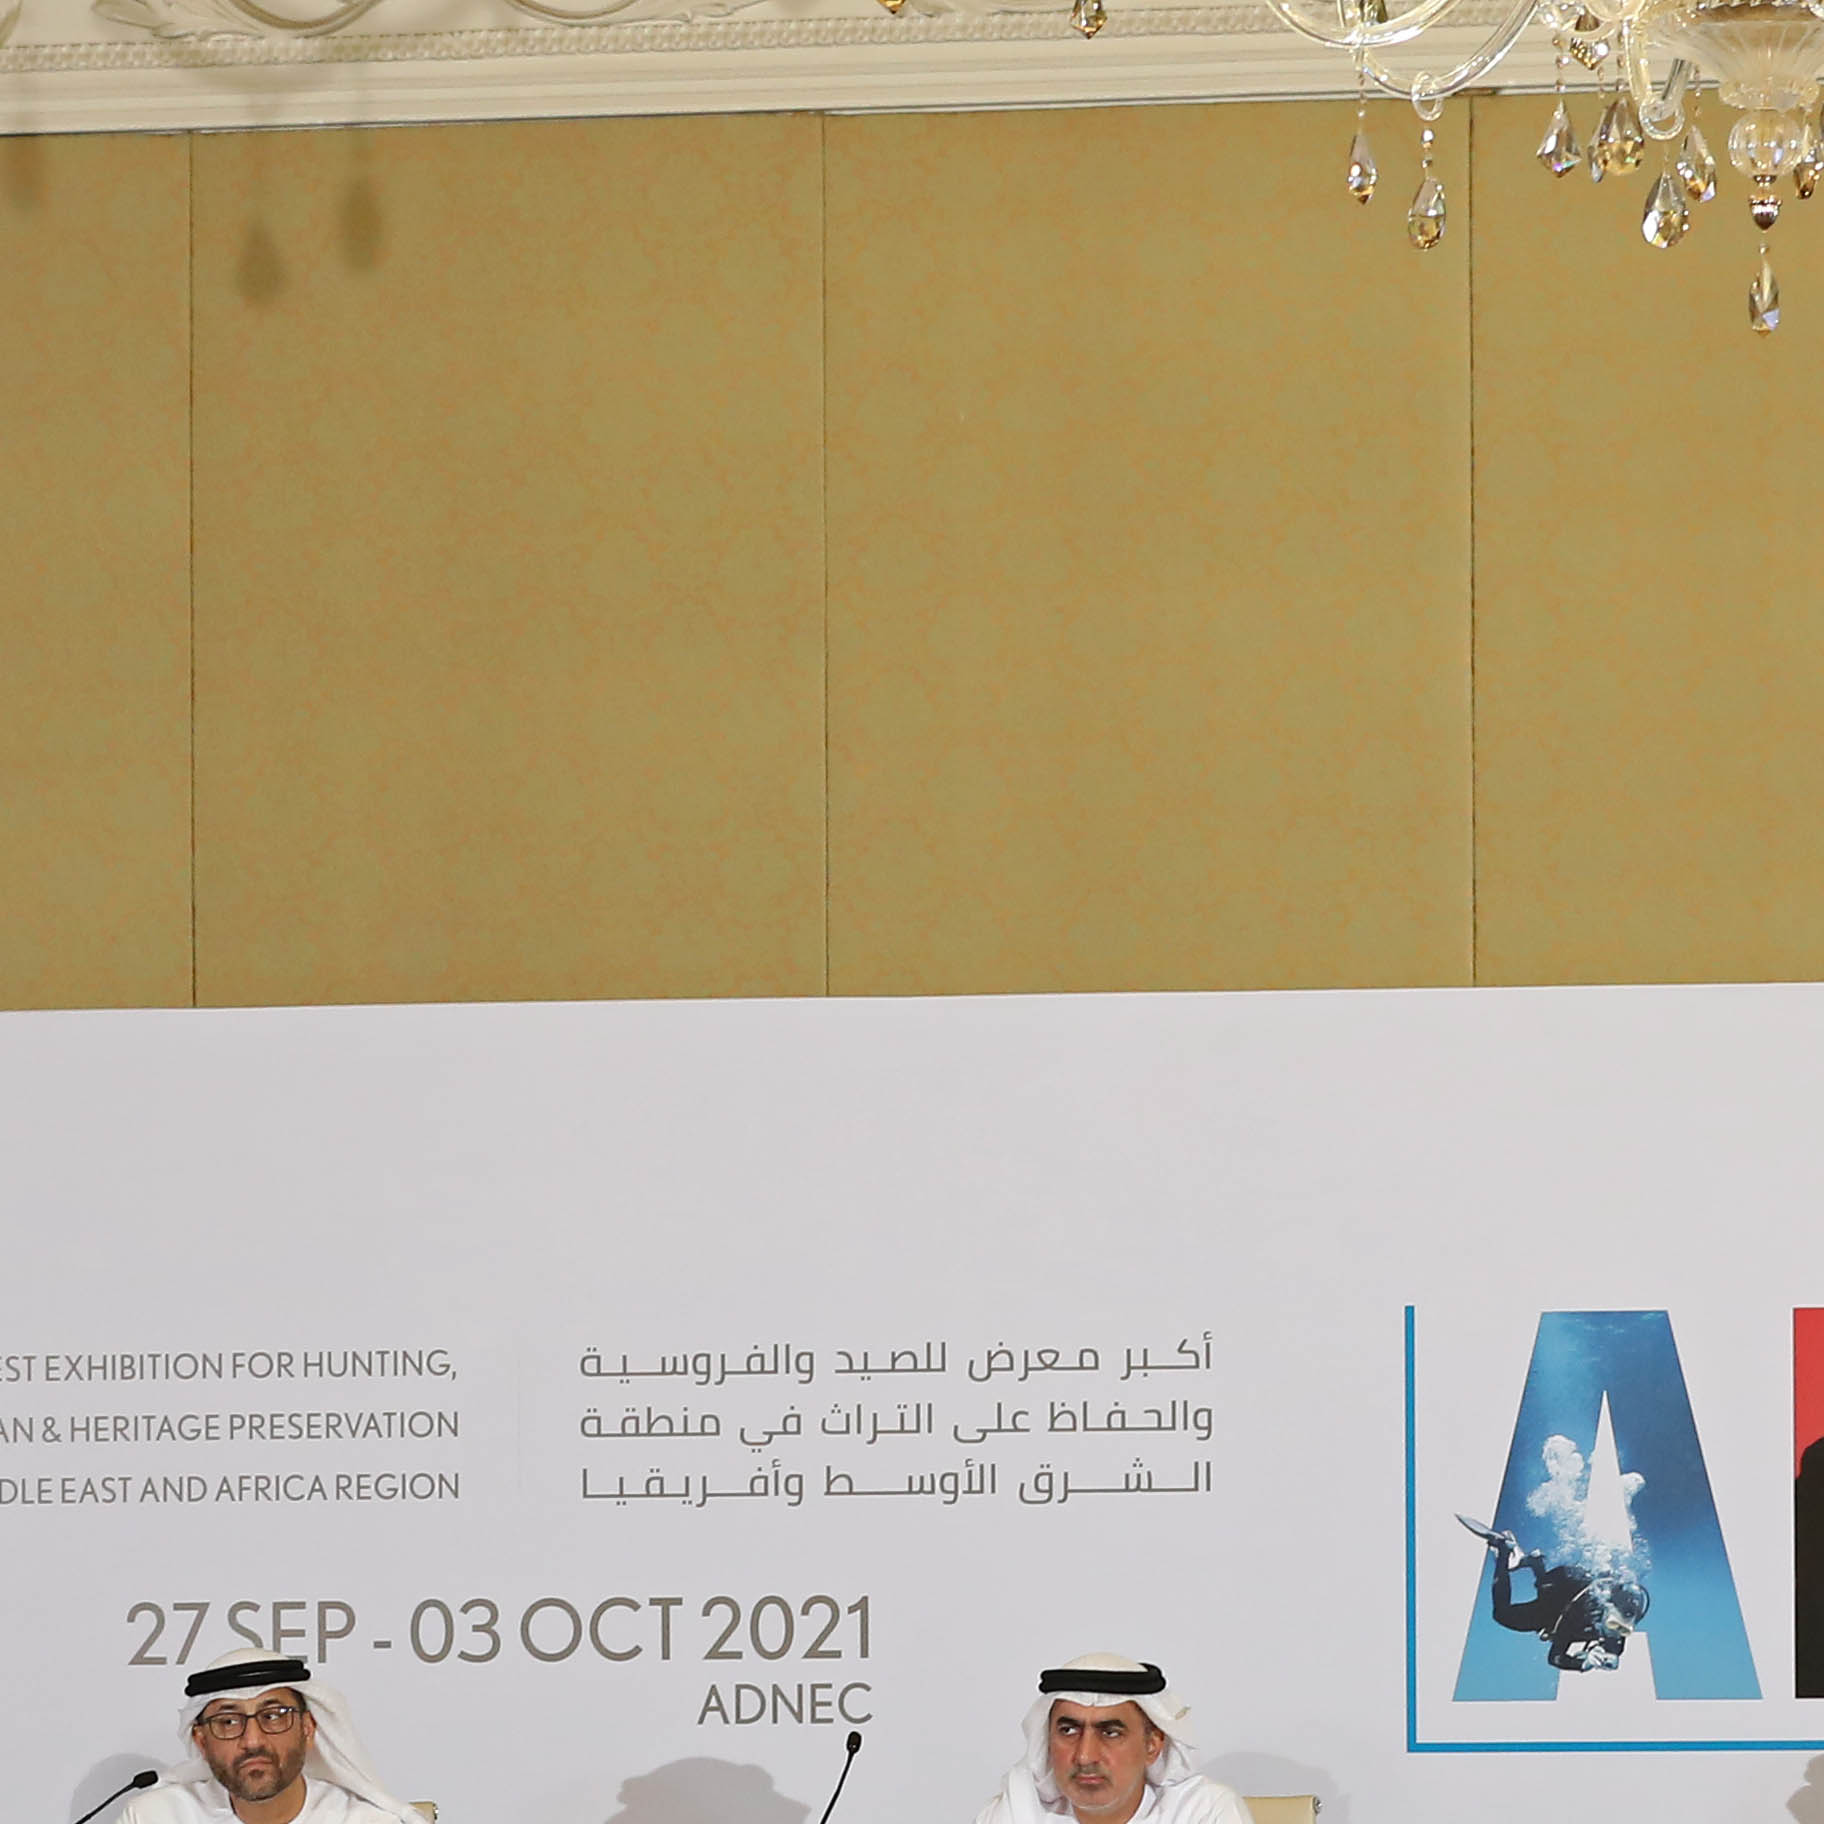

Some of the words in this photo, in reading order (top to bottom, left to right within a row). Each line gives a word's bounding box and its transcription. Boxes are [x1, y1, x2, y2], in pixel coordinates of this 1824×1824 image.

[45, 1352, 223, 1382] EXHIBITION
[232, 1351, 295, 1379] FOR
[303, 1349, 457, 1381] HUNTING,
[580, 1343, 814, 1386] والفروسية
[834, 1341, 946, 1381] للصيد
[968, 1341, 1100, 1383] معرض
[1119, 1330, 1213, 1381] أكبر
[41, 1416, 62, 1443] &
[70, 1414, 221, 1443] HERITAGE
[229, 1411, 459, 1441] PRESERVATION
[580, 1406, 720, 1438] منطقة
[739, 1405, 802, 1454] في
[821, 1402, 933, 1445] التراث
[953, 1401, 1031, 1444] على
[1047, 1399, 1213, 1441] والحفاظ
[61, 1476, 132, 1504] EAST
[139, 1475, 208, 1503] AND
[214, 1474, 328, 1502] AFRICA
[335, 1472, 459, 1501] REGION
[582, 1458, 804, 1508] وأفريقيا
[823, 1458, 996, 1505] الأوسط
[1018, 1457, 1211, 1505] الشرق
[126, 1601, 211, 1666] 27
[226, 1600, 357, 1665] SEP
[410, 1598, 501, 1664] 03
[519, 1596, 684, 1663] OCT
[701, 1594, 869, 1661] 2021
[697, 1682, 873, 1726] ADNEC
